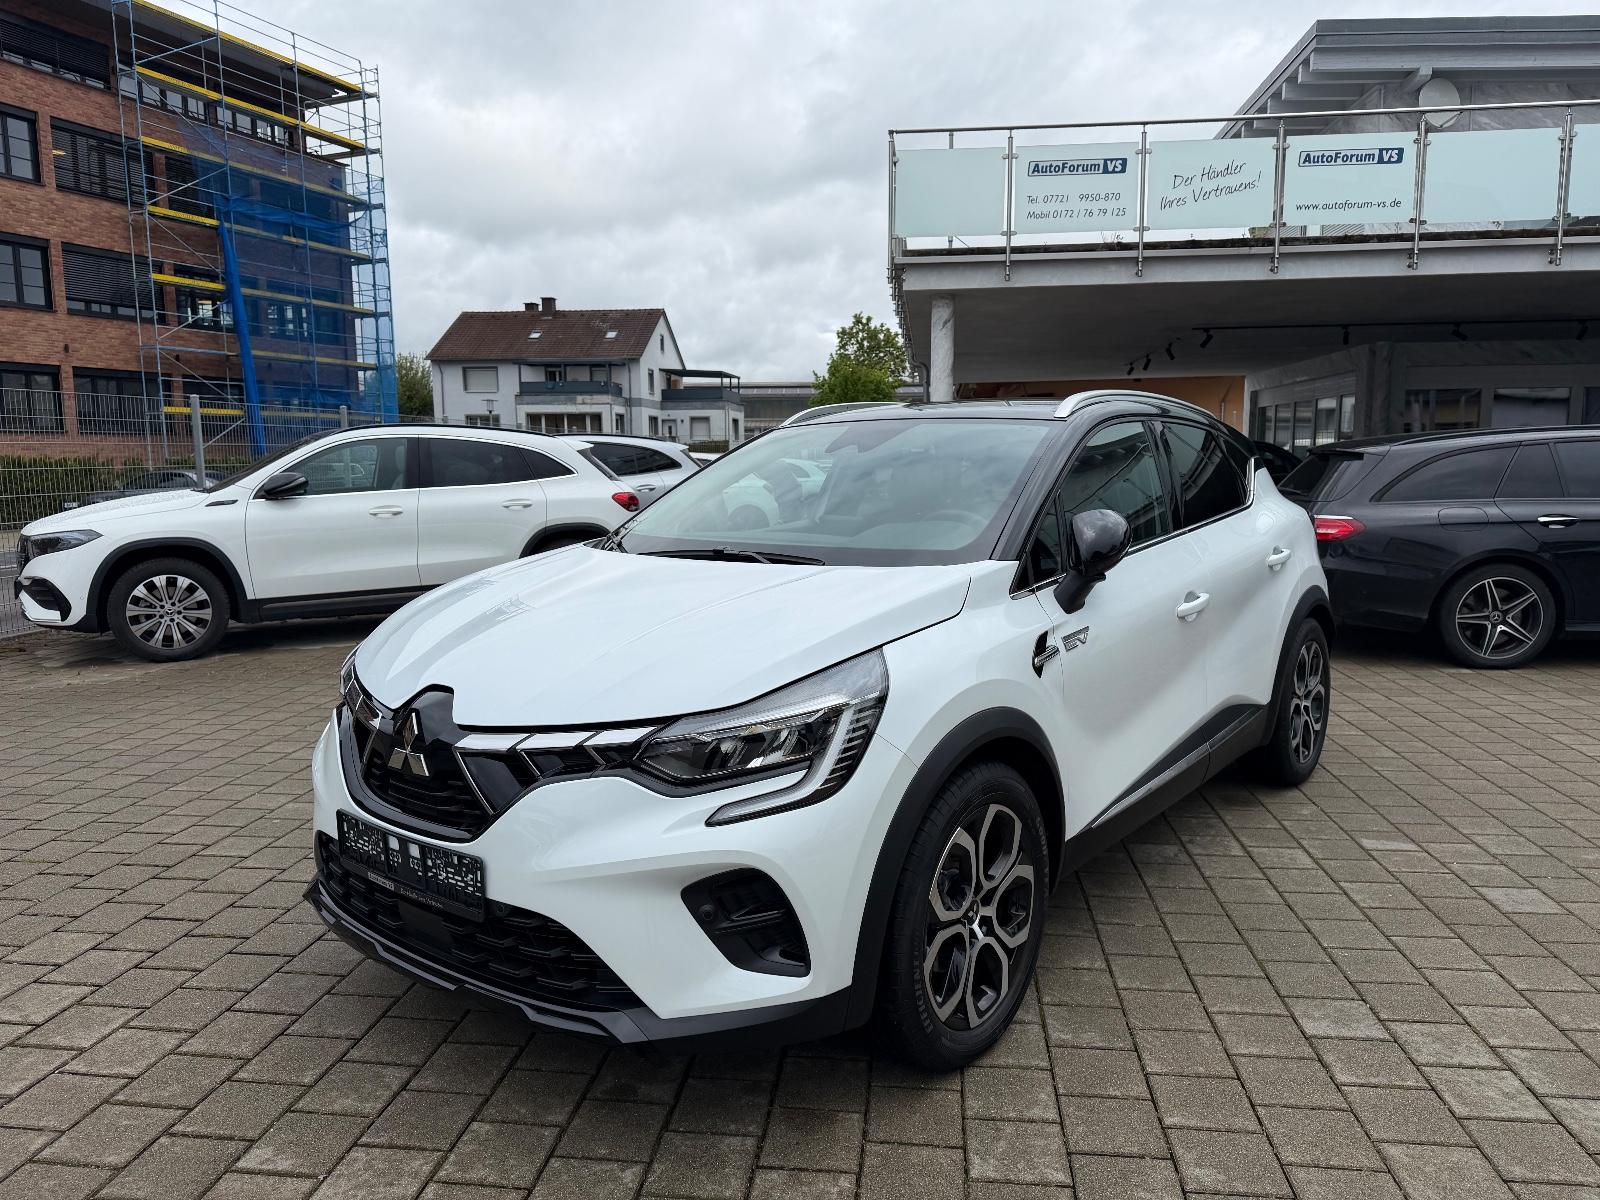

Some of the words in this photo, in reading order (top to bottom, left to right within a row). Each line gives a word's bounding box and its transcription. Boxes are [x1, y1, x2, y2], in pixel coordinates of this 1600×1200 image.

[1303, 151, 1376, 164] AutoForum
[1382, 149, 1399, 161] VS
[1031, 162, 1101, 175] AutoForum
[1107, 159, 1123, 171] VS
[1173, 173, 1197, 190] Der
[1200, 159, 1247, 182] Händler
[1160, 195, 1187, 211] Ihres
[1192, 170, 1261, 203] Vertrauens!
[1027, 195, 1040, 205] Tel.
[1043, 194, 1069, 204] 07721
[1078, 193, 1121, 202] 9950-870
[1295, 198, 1402, 212] www.autoforum-vs.de
[1027, 210, 1051, 220] Mobil
[1052, 209, 1075, 219] 0172
[1083, 209, 1094, 218] 76
[1096, 208, 1108, 218] 79
[1111, 207, 1127, 217] 125
